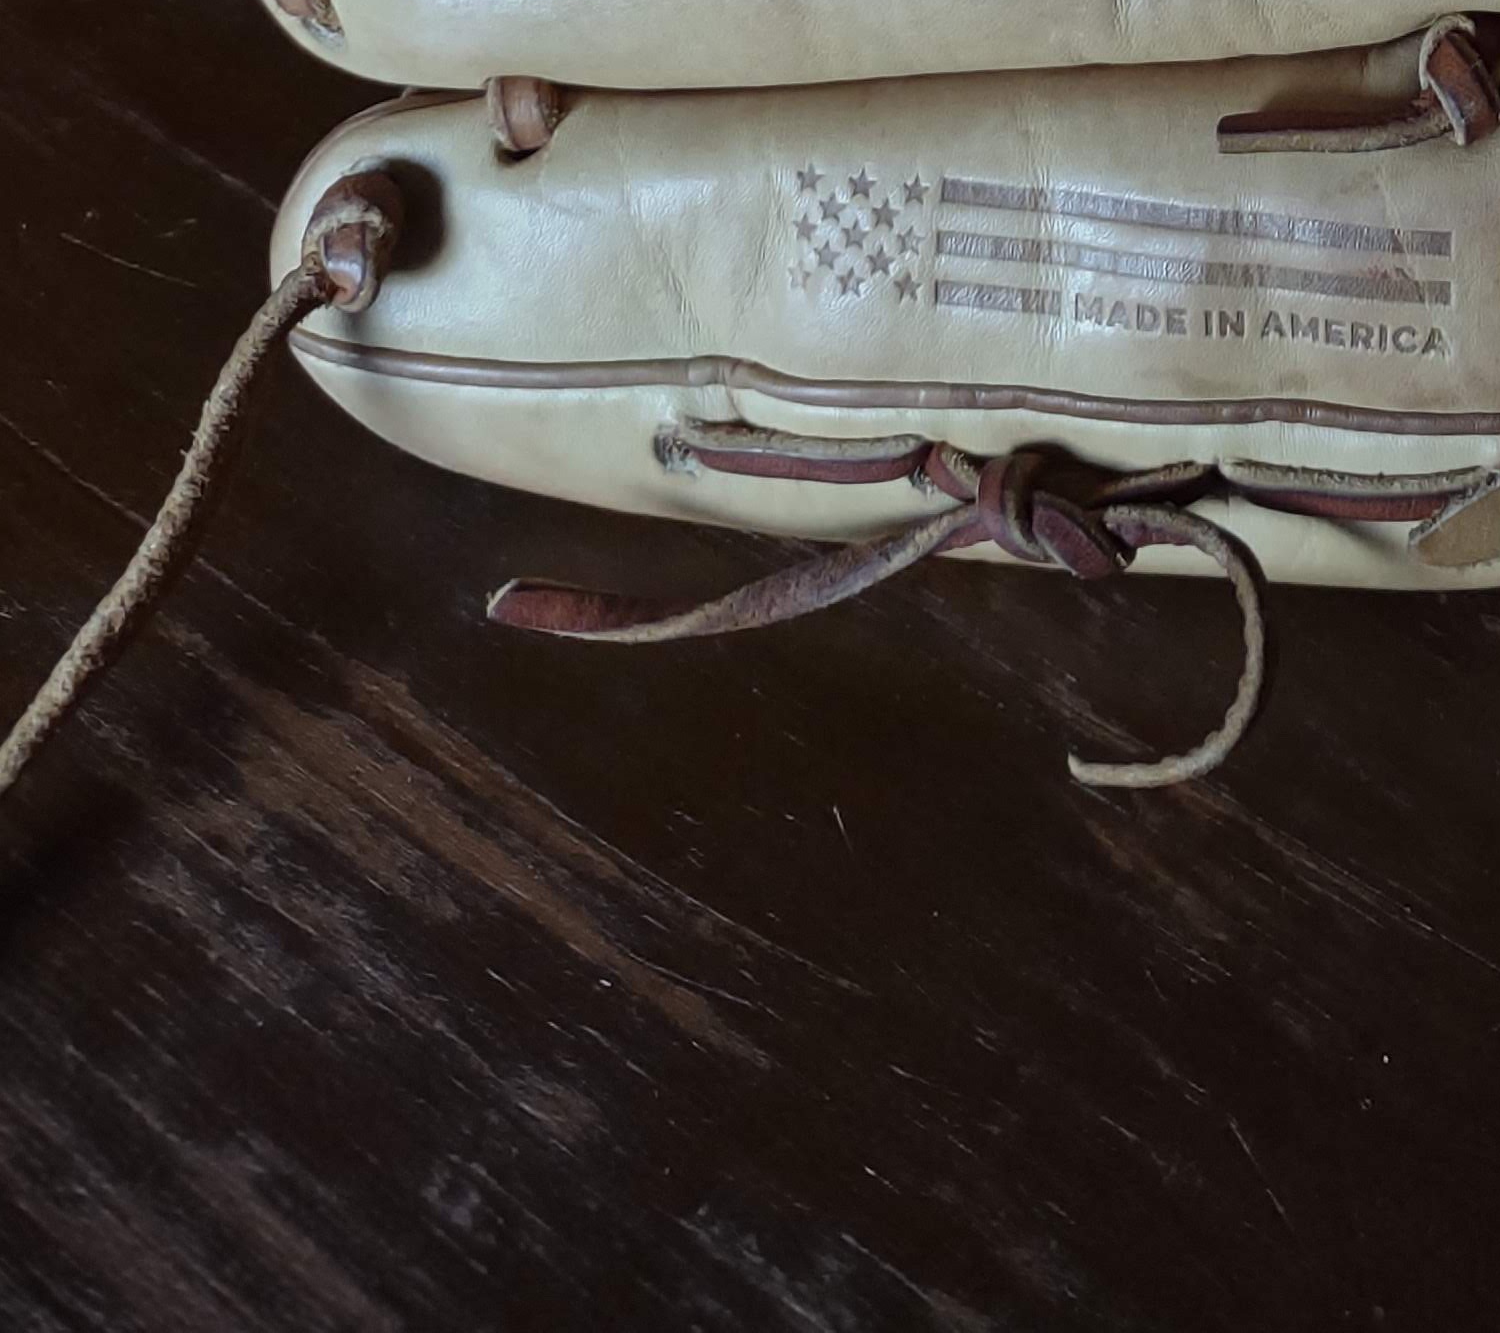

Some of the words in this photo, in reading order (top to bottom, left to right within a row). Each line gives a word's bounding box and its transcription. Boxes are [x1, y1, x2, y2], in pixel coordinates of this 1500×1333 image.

[1074, 290, 1187, 335] MADE
[1204, 309, 1245, 337] IN
[1262, 309, 1451, 357] AMERICA
